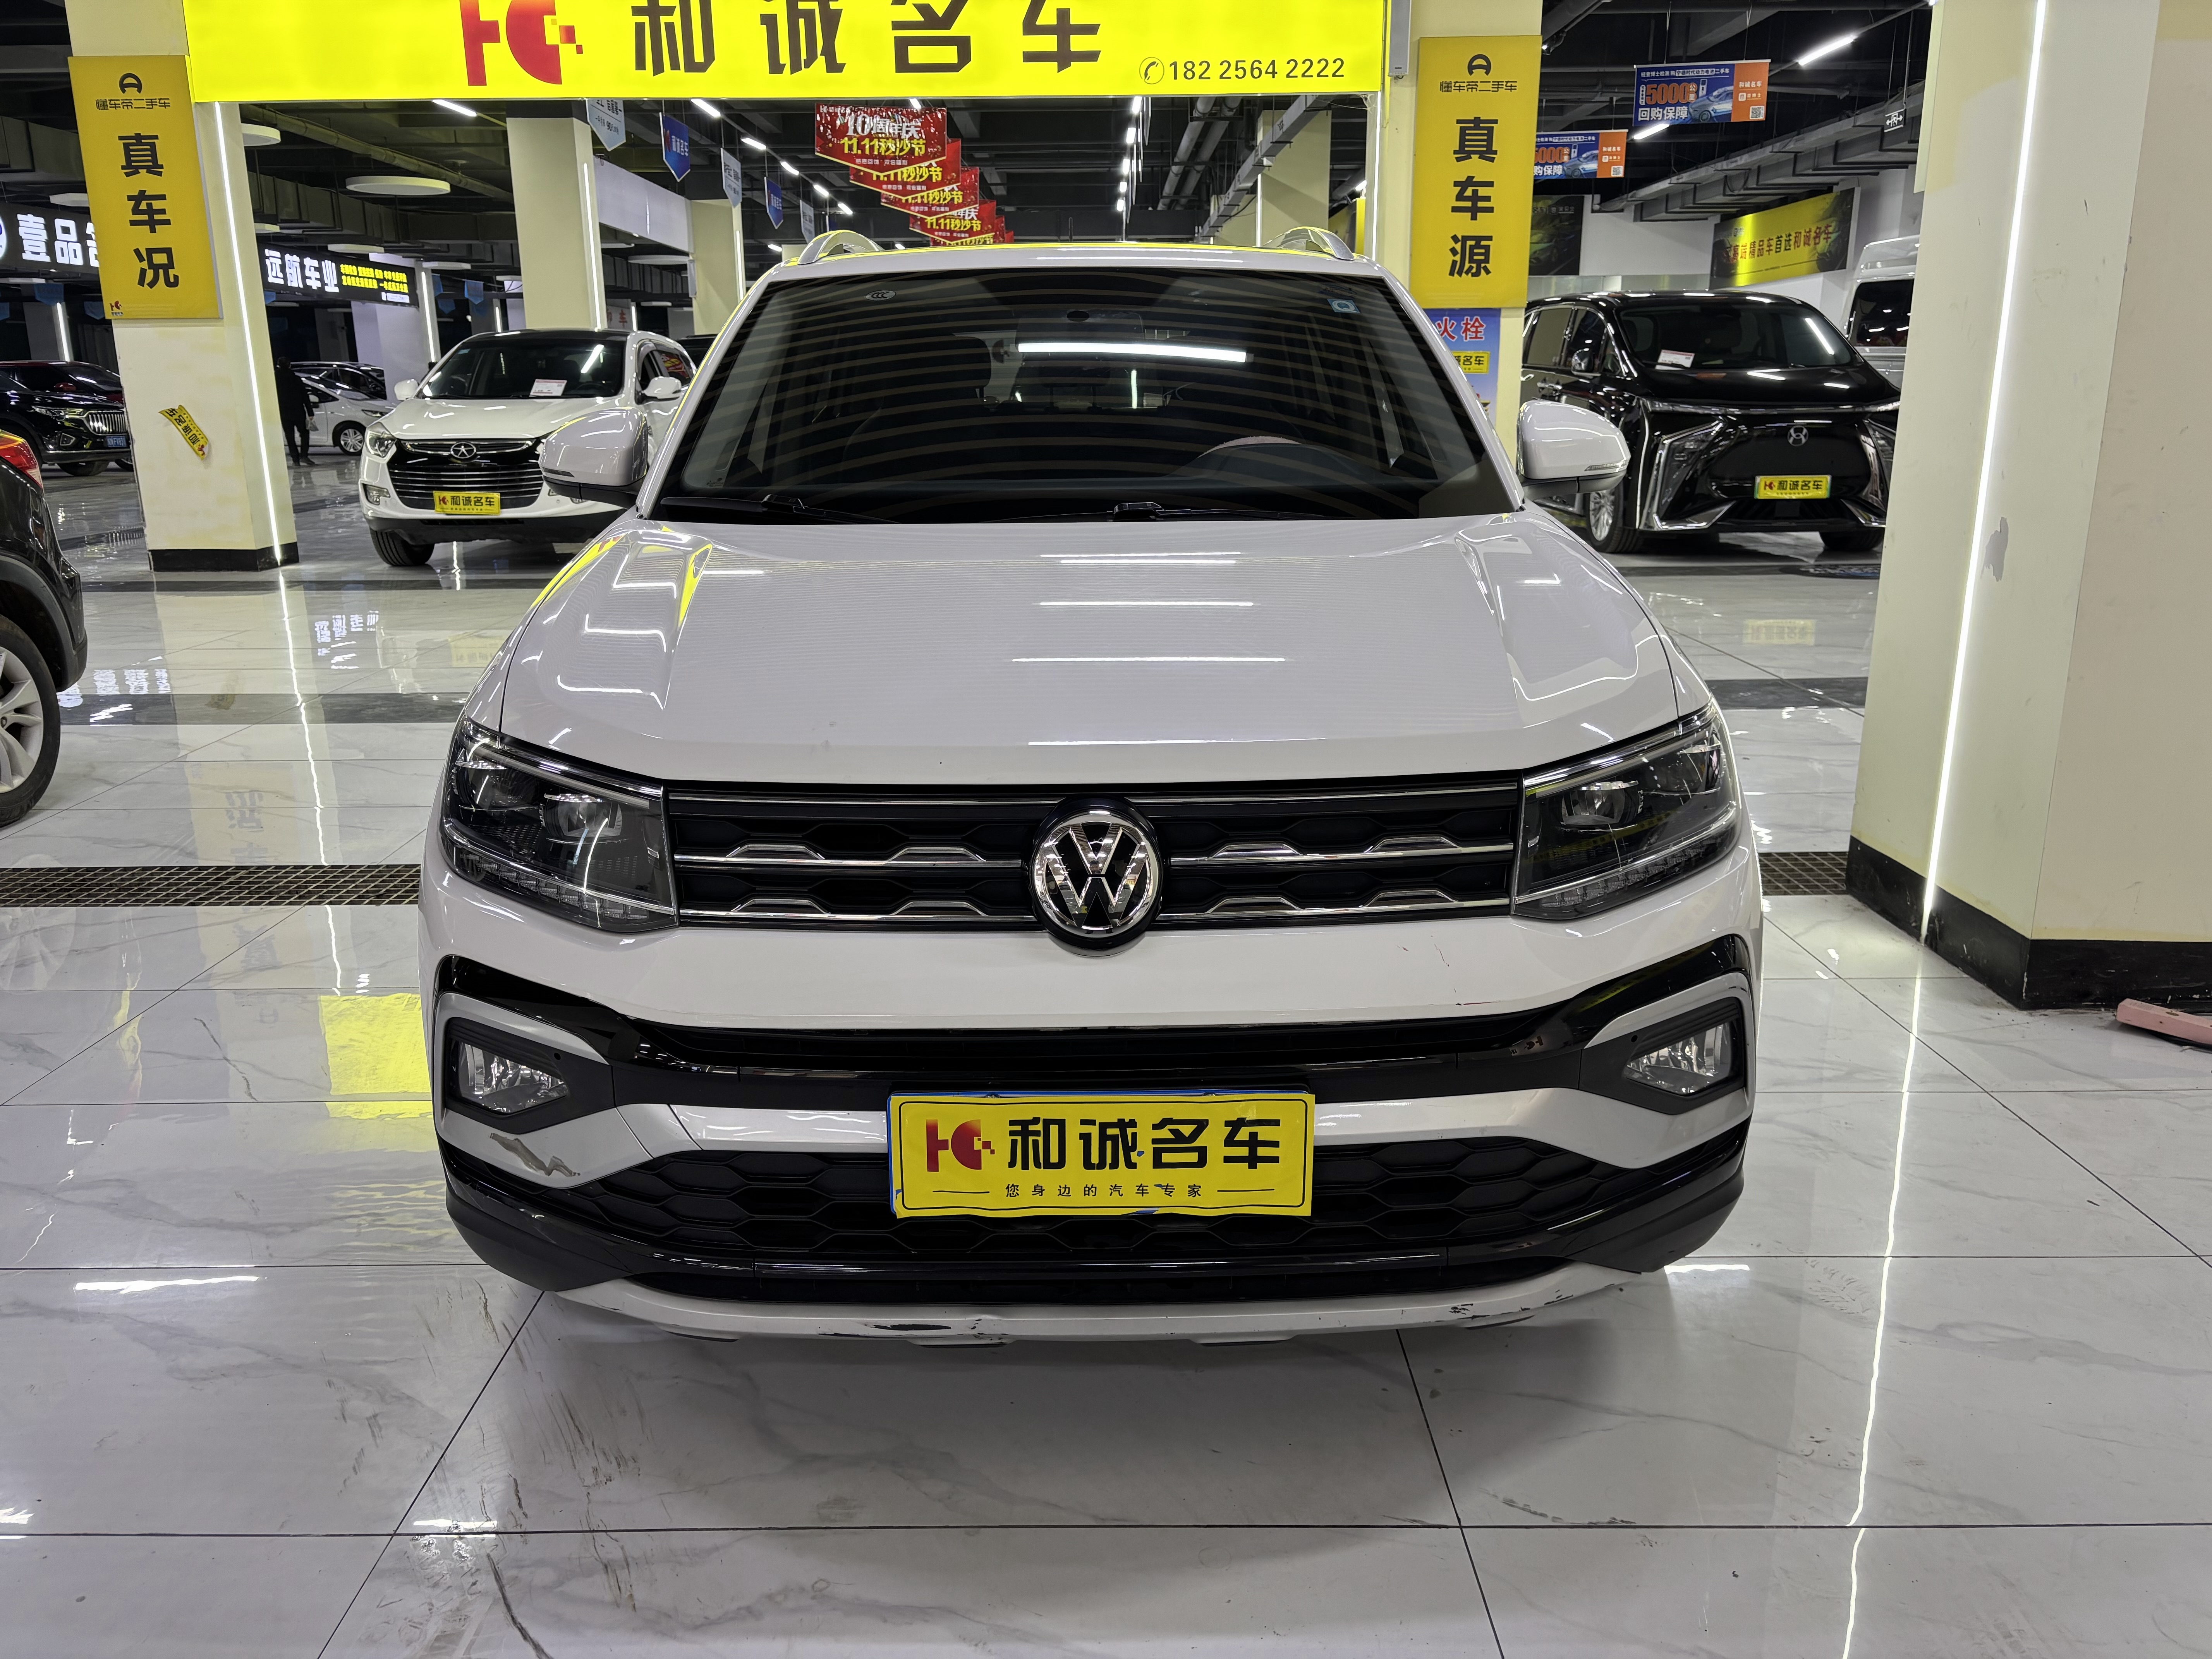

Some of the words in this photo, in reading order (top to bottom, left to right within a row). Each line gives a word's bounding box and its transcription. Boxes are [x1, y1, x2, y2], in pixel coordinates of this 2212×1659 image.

[631, 0, 1101, 76] 和诚名车
[1170, 60, 1211, 80] 182
[1219, 59, 1278, 79] 2564
[1286, 58, 1345, 78] 2222
[1439, 81, 1517, 93] 懂车帝二手车
[1646, 82, 1688, 105] 5000
[96, 98, 170, 110] 懂车帝二手车
[1638, 106, 1688, 121] 回购保障
[1448, 117, 1499, 278] 真车源
[118, 132, 179, 289] 真车况
[265, 249, 339, 293] 远航车业
[1777, 480, 1823, 491] 和诚名车
[450, 495, 495, 507] 和诚名车
[1008, 1117, 1281, 1171] 和诚名车
[1005, 1183, 1202, 1198] 您身边的汽车专家
